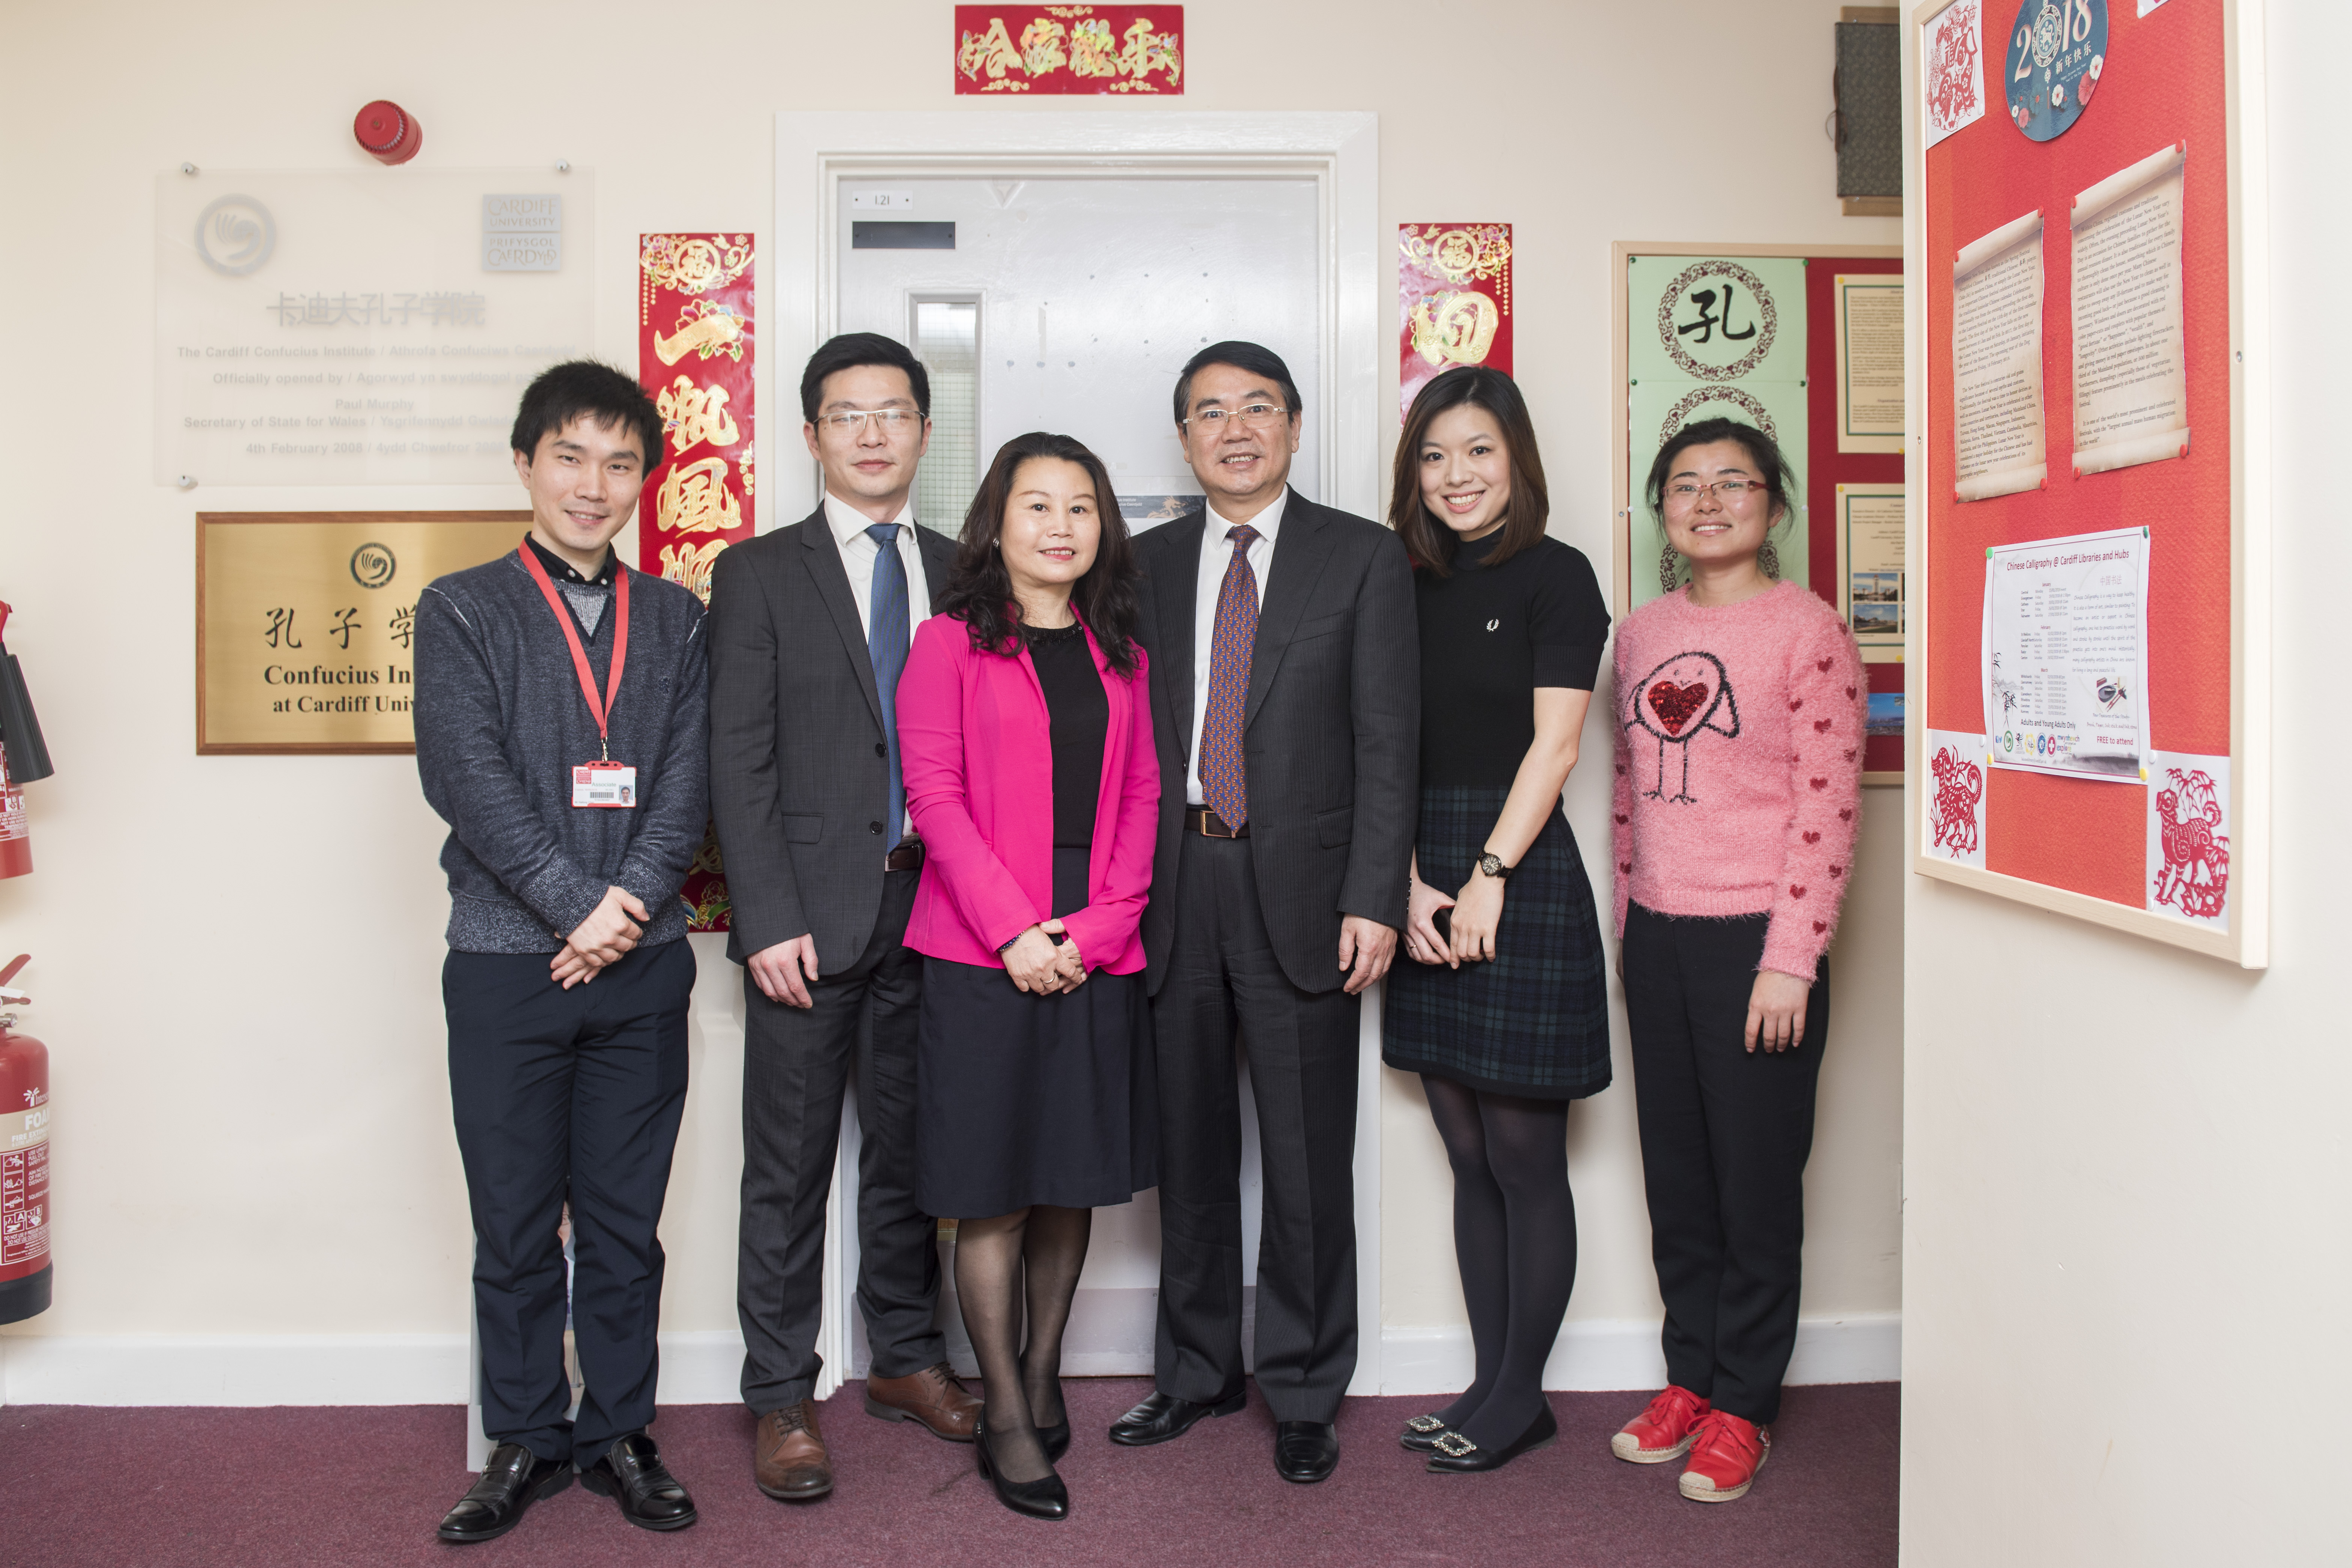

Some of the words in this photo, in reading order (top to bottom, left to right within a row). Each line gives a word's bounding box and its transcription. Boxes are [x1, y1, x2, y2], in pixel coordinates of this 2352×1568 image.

[1945, 41, 1954, 68] 福
[2055, 41, 2092, 75] 新年快乐
[488, 198, 557, 216] CARDIFF
[875, 195, 890, 205] 1.21
[2104, 211, 2117, 222] regional
[2119, 207, 2132, 215] customs
[2141, 196, 2158, 206] traditions
[490, 217, 555, 227] UNIVERSITY
[2102, 222, 2120, 233] celebration
[2106, 233, 2119, 241] evening
[2120, 225, 2136, 238] preceding
[490, 238, 555, 247] PRIFYSGOL
[2093, 248, 2107, 257] occasion
[2113, 240, 2126, 248] Chinese
[2127, 234, 2140, 243] families
[2146, 226, 2157, 235] gather
[266, 291, 485, 326] 卡迪夫孔子学院
[1678, 284, 1756, 343] 孔
[177, 346, 200, 357] The
[206, 346, 249, 357] Cardiff
[254, 346, 318, 357] Confucius
[324, 345, 375, 356] Institute
[380, 345, 384, 356] /
[390, 345, 435, 355] Athrofa
[442, 345, 509, 355] Confuciws
[515, 344, 576, 357] Caerdydd
[213, 373, 270, 385] Officially
[276, 373, 322, 385] opened
[328, 373, 342, 385] by
[348, 373, 351, 382] /
[357, 372, 415, 385] Agorwyd
[420, 375, 435, 384] yn
[441, 372, 510, 385] swyddogol
[335, 399, 362, 409] Paul
[367, 399, 414, 411] Murphy
[184, 416, 246, 429] Secretary
[251, 416, 265, 427] of
[269, 416, 301, 427] State
[306, 416, 324, 427] for
[328, 416, 366, 426] Wales
[371, 416, 375, 426] /
[380, 415, 463, 428] Ysgrifennydd
[246, 443, 265, 453] 4th
[271, 443, 328, 455] February
[333, 443, 363, 453] 2008
[368, 443, 372, 452] /
[376, 441, 406, 453] 4ydd
[412, 441, 470, 453] Chwefror
[475, 442, 504, 452] 2008
[2007, 562, 2024, 571] Chinese
[2026, 557, 2052, 569] Calligraphy
[2054, 557, 2058, 567] @
[2060, 554, 2078, 565] Cardiff
[2079, 553, 2101, 563] Libraries
[2102, 550, 2113, 560] and
[2114, 549, 2129, 559] Hubs
[2100, 575, 2122, 586] 中国书法
[265, 604, 416, 650] 孔子学
[264, 665, 379, 685] Confucius
[273, 697, 291, 712] at
[297, 696, 370, 713] Cardiff
[2042, 720, 2054, 729] Young
[2067, 721, 2076, 731] Only
[2057, 734, 2079, 743] mwynhewch
[12, 1133, 27, 1142] FIRE
